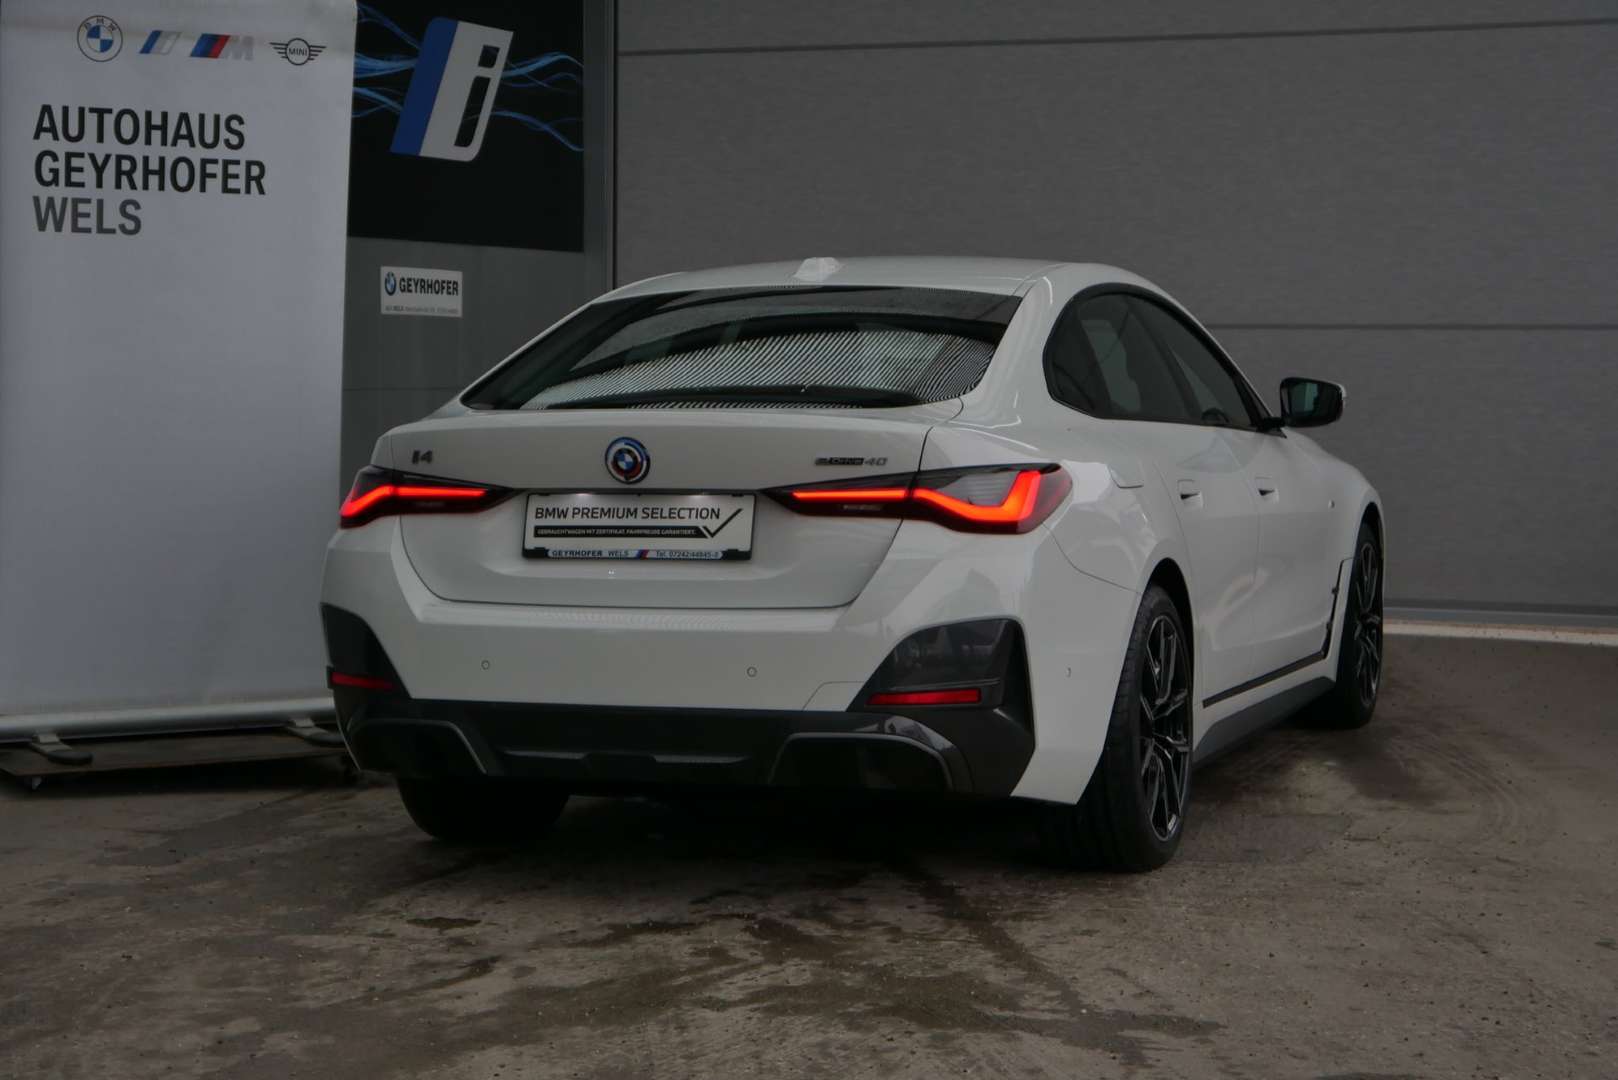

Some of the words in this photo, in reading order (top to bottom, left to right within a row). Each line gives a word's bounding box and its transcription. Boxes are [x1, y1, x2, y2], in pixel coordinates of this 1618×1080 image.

[288, 47, 307, 57] MINI
[33, 104, 245, 150] AUTOHAUS
[34, 150, 266, 195] GEYRHOFER
[33, 196, 142, 236] WELS
[399, 277, 459, 296] GEYRHOFER
[535, 507, 569, 519] BMW
[572, 507, 637, 519] PREMIUM
[641, 507, 720, 520] SELECTION
